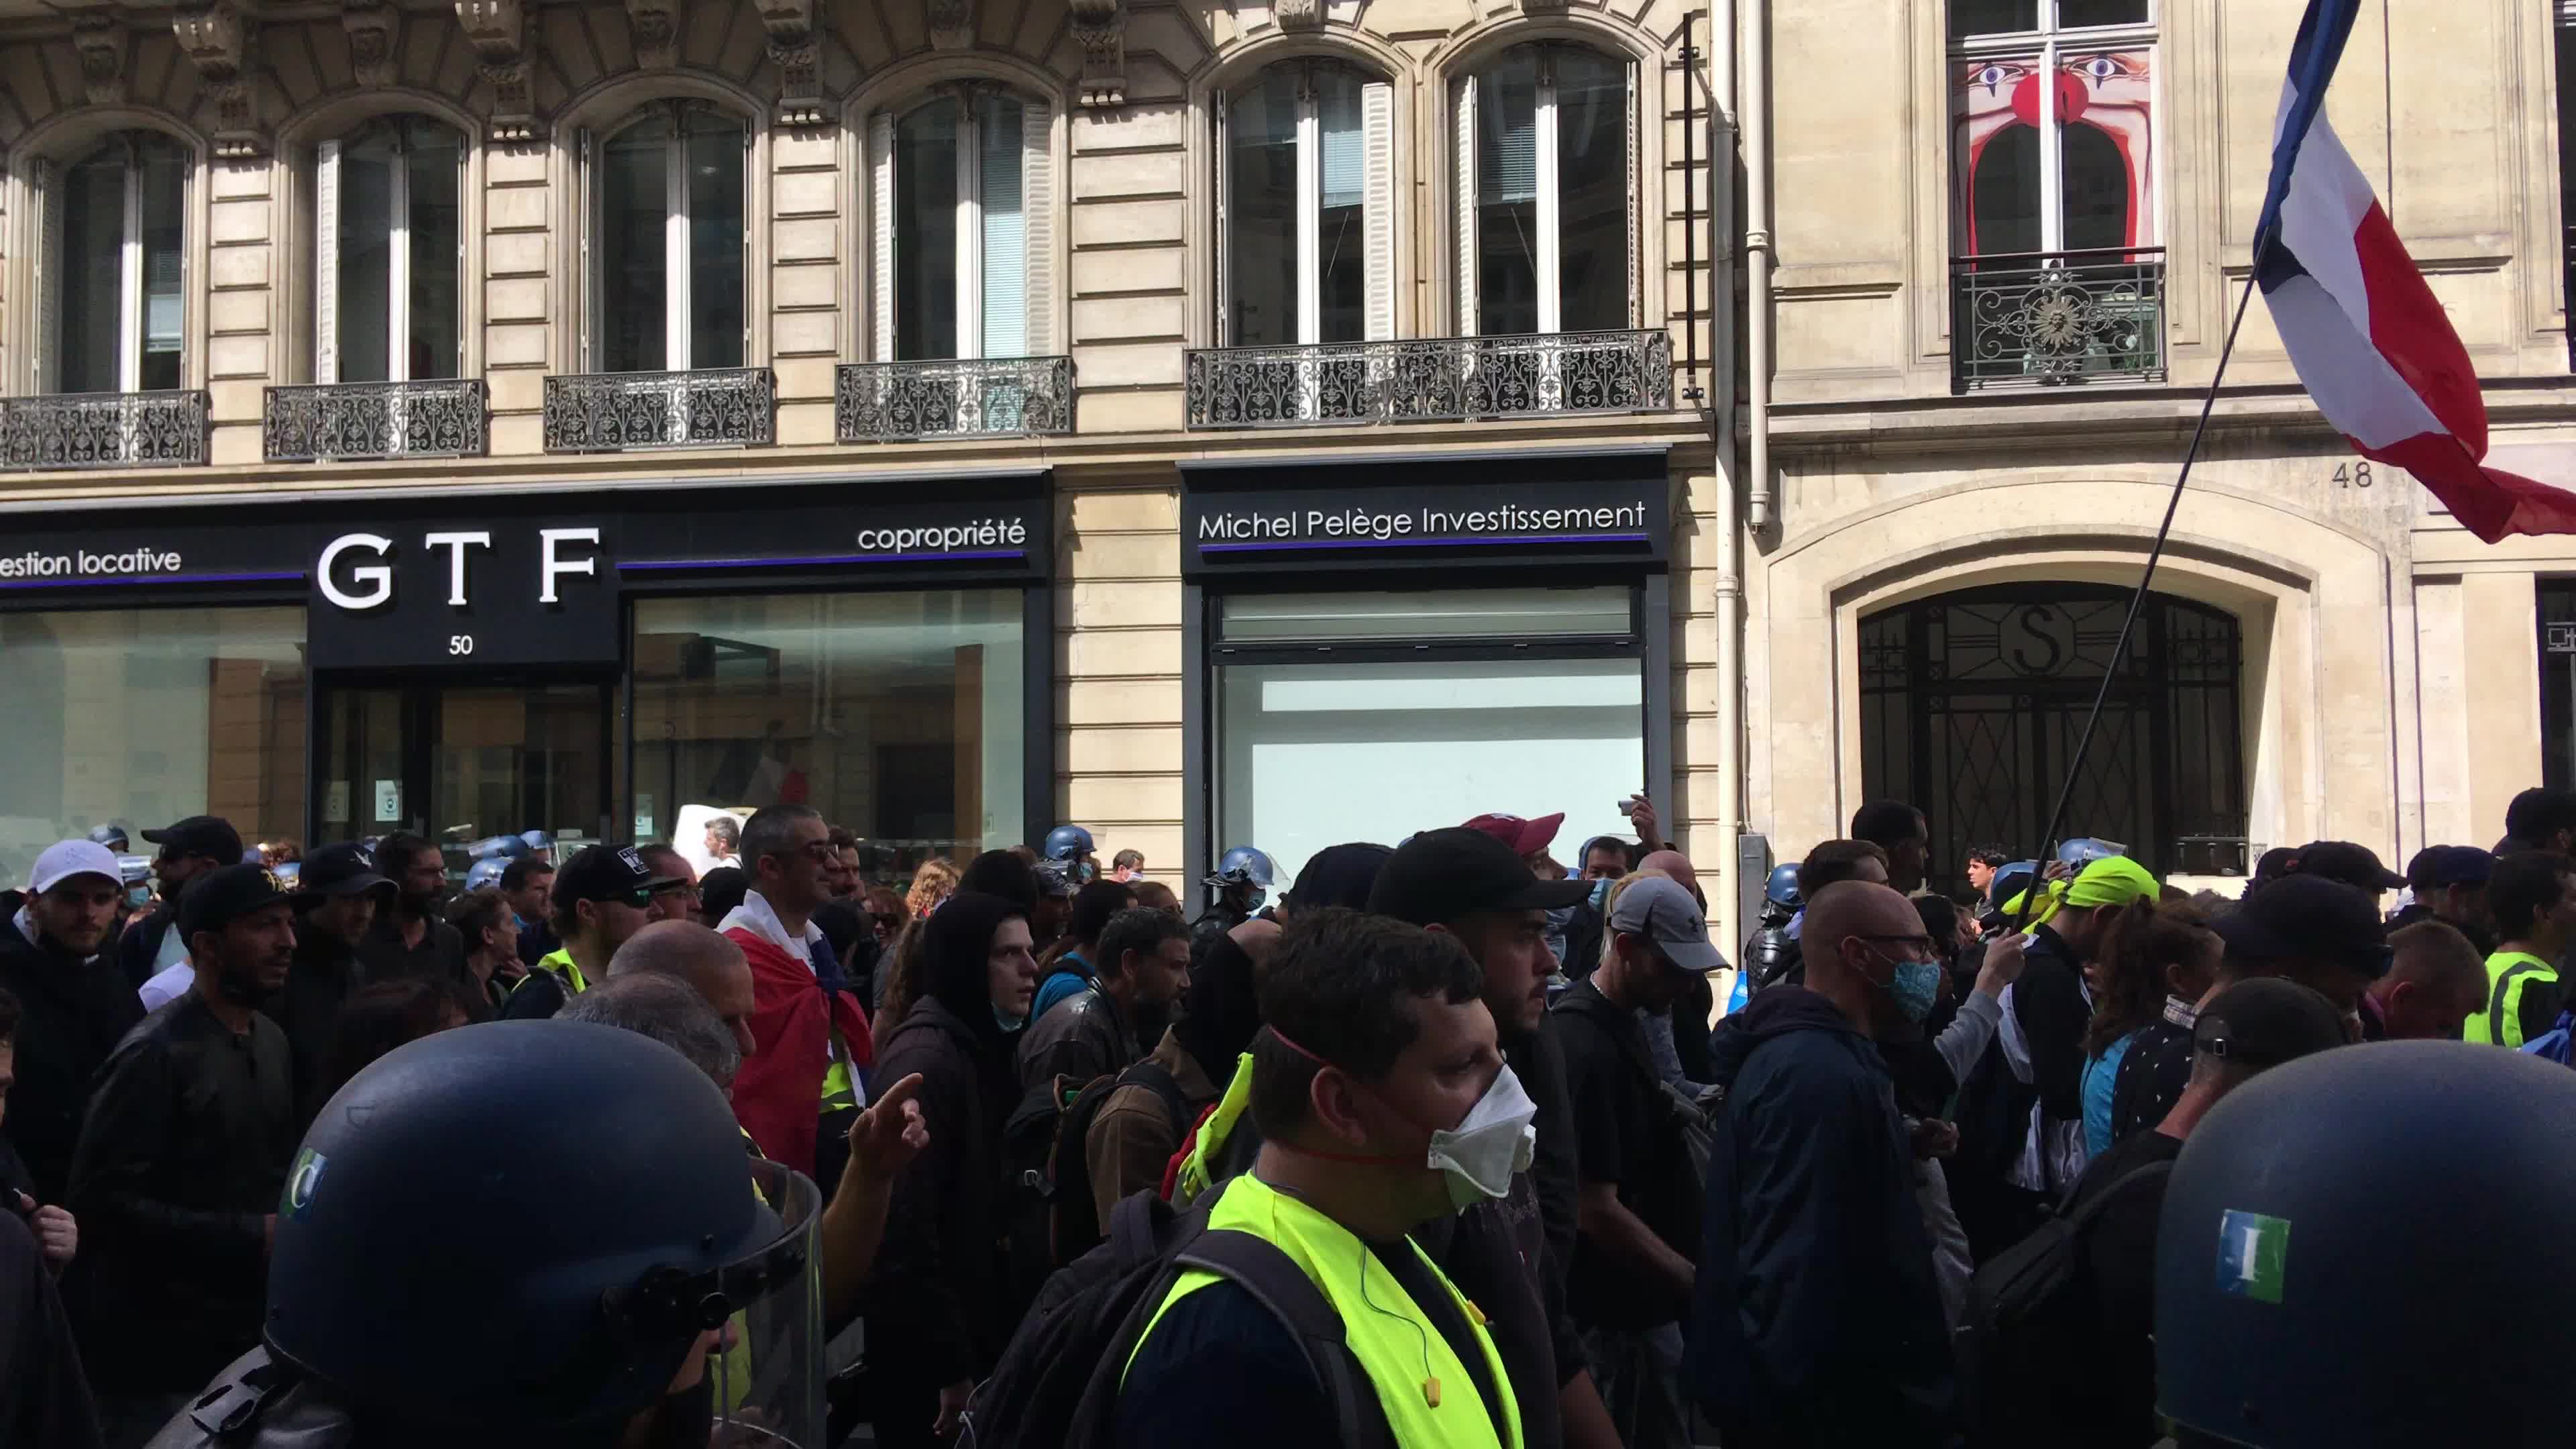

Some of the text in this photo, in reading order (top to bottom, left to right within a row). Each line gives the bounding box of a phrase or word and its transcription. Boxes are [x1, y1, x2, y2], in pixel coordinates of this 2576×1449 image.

[2332, 462, 2373, 489] 48
[1199, 500, 1646, 541] Michel Pelège Investissement
[858, 517, 1026, 553] copropriété
[78, 547, 181, 574] locative
[449, 635, 473, 655] 50
